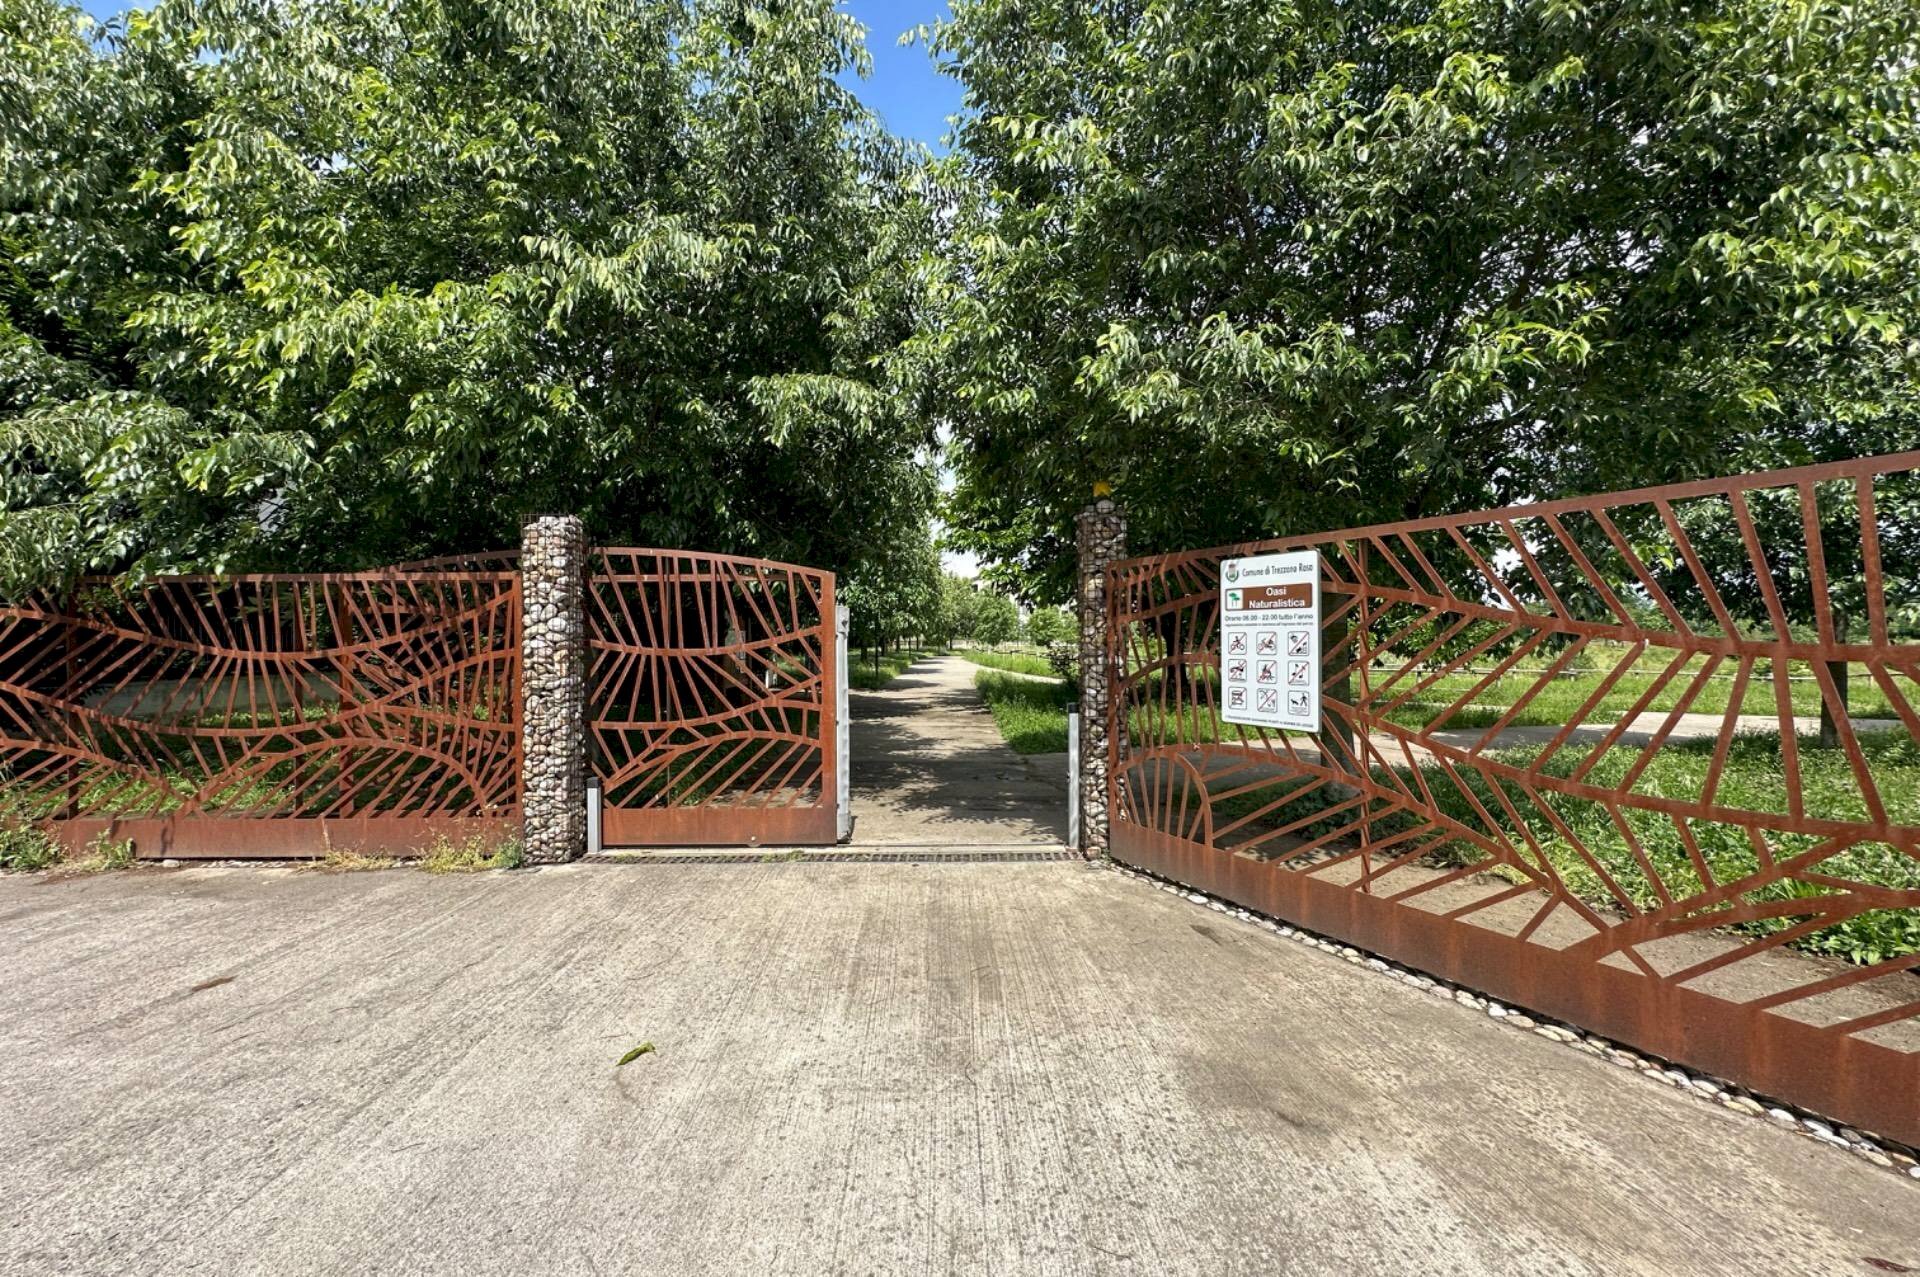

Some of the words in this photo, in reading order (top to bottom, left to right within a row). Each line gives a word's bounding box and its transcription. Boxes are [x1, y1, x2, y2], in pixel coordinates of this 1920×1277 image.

[1242, 568, 1263, 577] Comune
[1265, 565, 1270, 575] di
[1265, 586, 1287, 596] Oasi
[1248, 598, 1305, 609] Naturalistica
